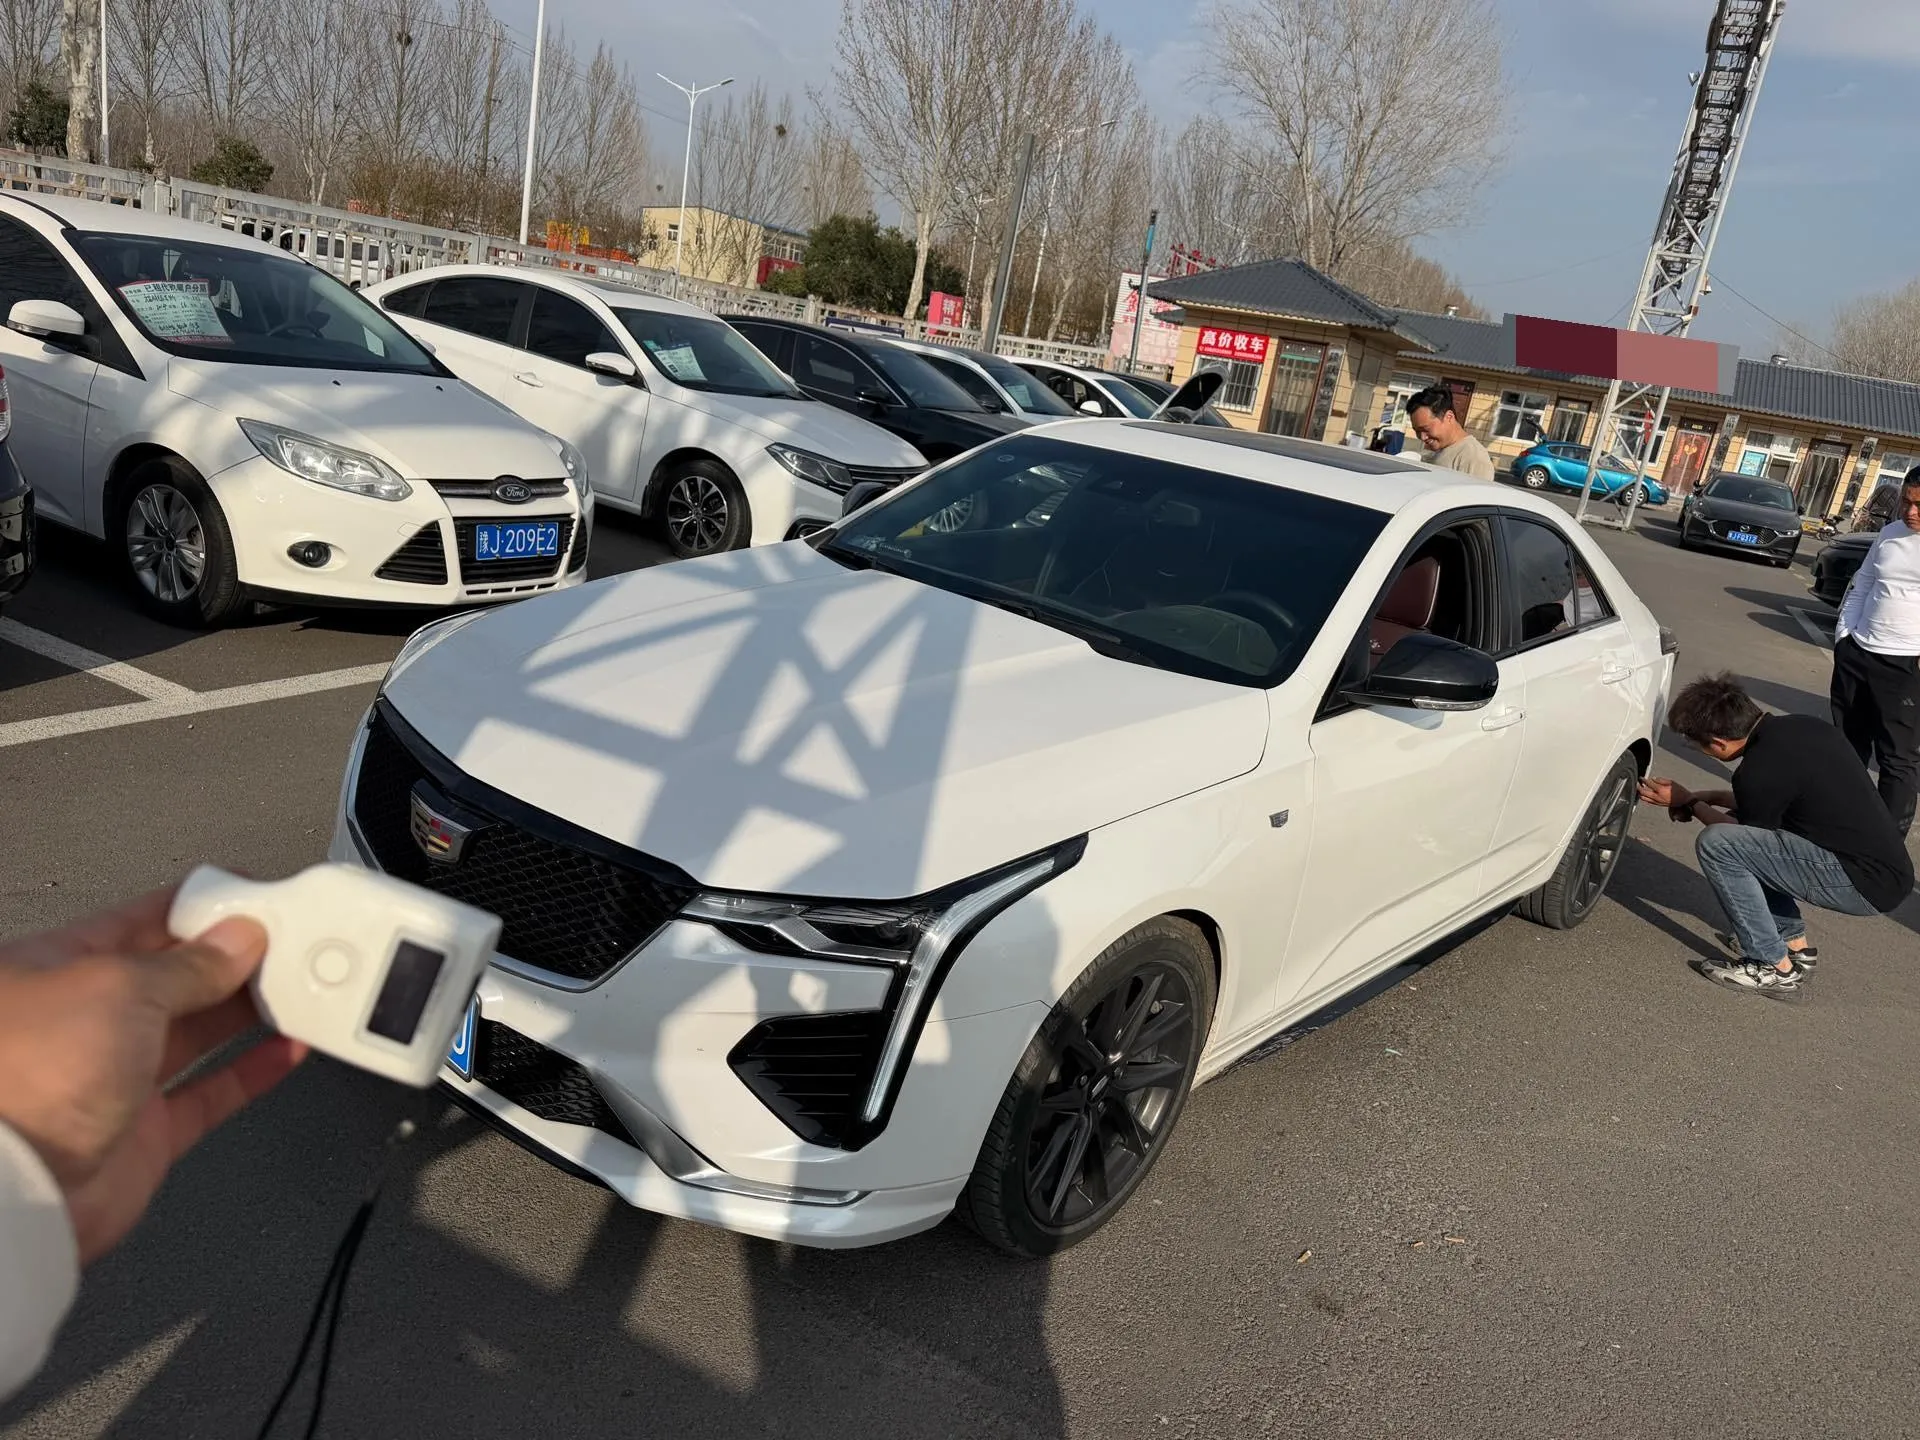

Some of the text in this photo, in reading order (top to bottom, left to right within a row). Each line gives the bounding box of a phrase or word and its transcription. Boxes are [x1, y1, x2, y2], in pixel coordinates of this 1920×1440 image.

[1201, 330, 1265, 353] 高价收车
[506, 486, 525, 497] Ford
